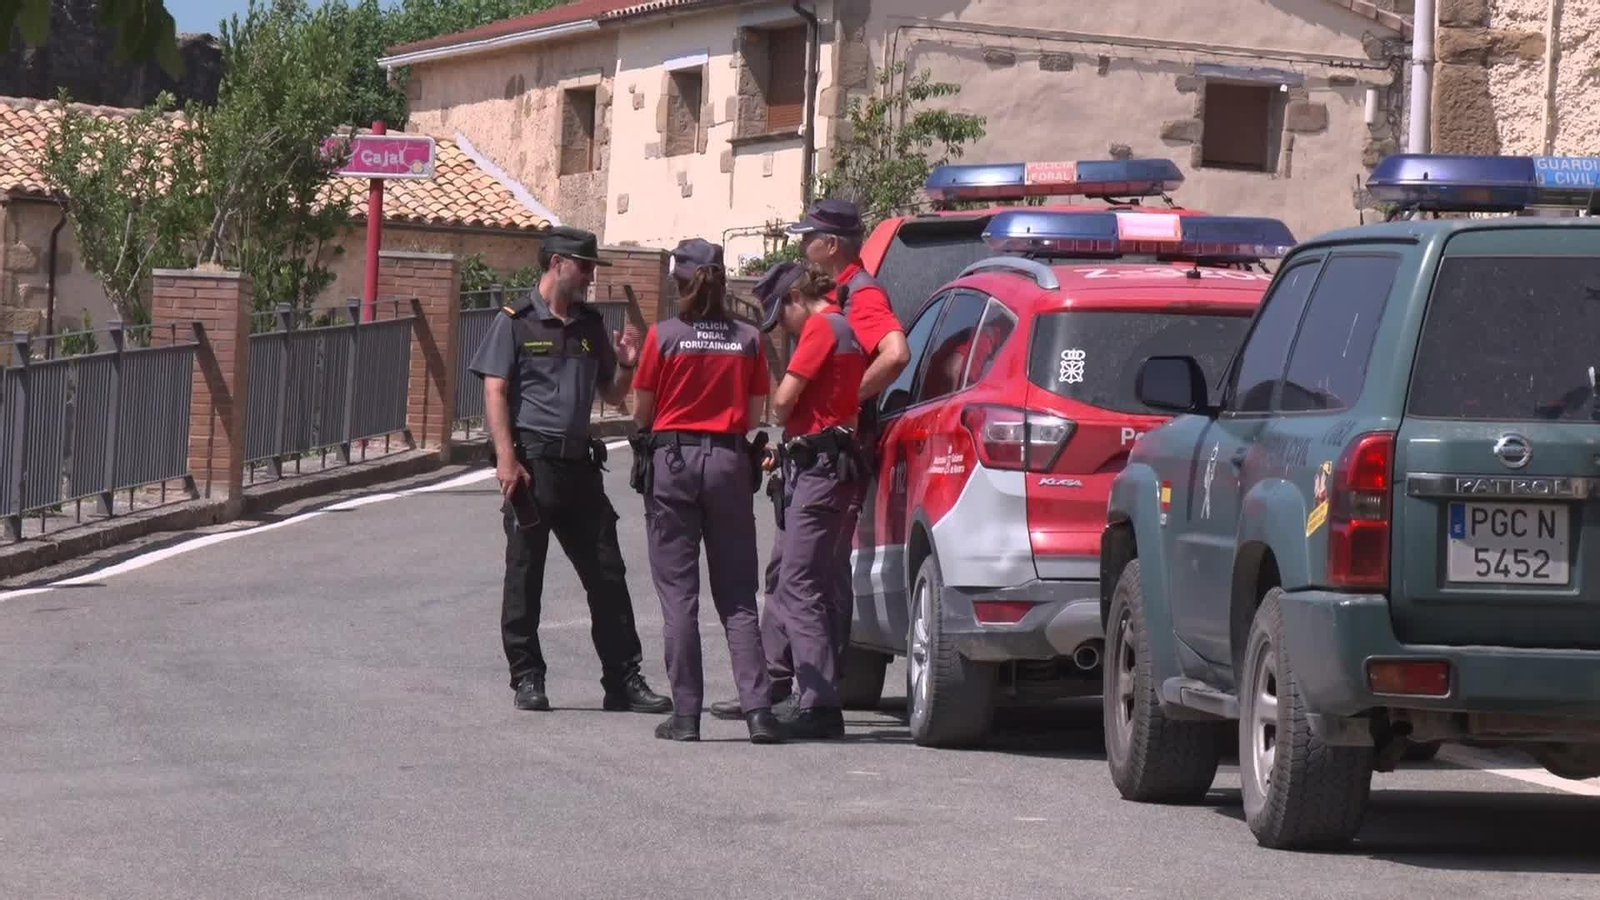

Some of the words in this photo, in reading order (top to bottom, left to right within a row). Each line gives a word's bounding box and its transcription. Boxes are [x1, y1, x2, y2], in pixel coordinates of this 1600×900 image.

[1536, 158, 1600, 171] GUARDI
[1554, 172, 1596, 185] CIVIL
[697, 331, 726, 340] FORAL
[679, 341, 743, 351] FORUZAINGOA
[1455, 478, 1573, 494] PATROL
[1470, 507, 1528, 538] PGC
[1538, 509, 1556, 539] N
[1474, 548, 1551, 579] 5452
